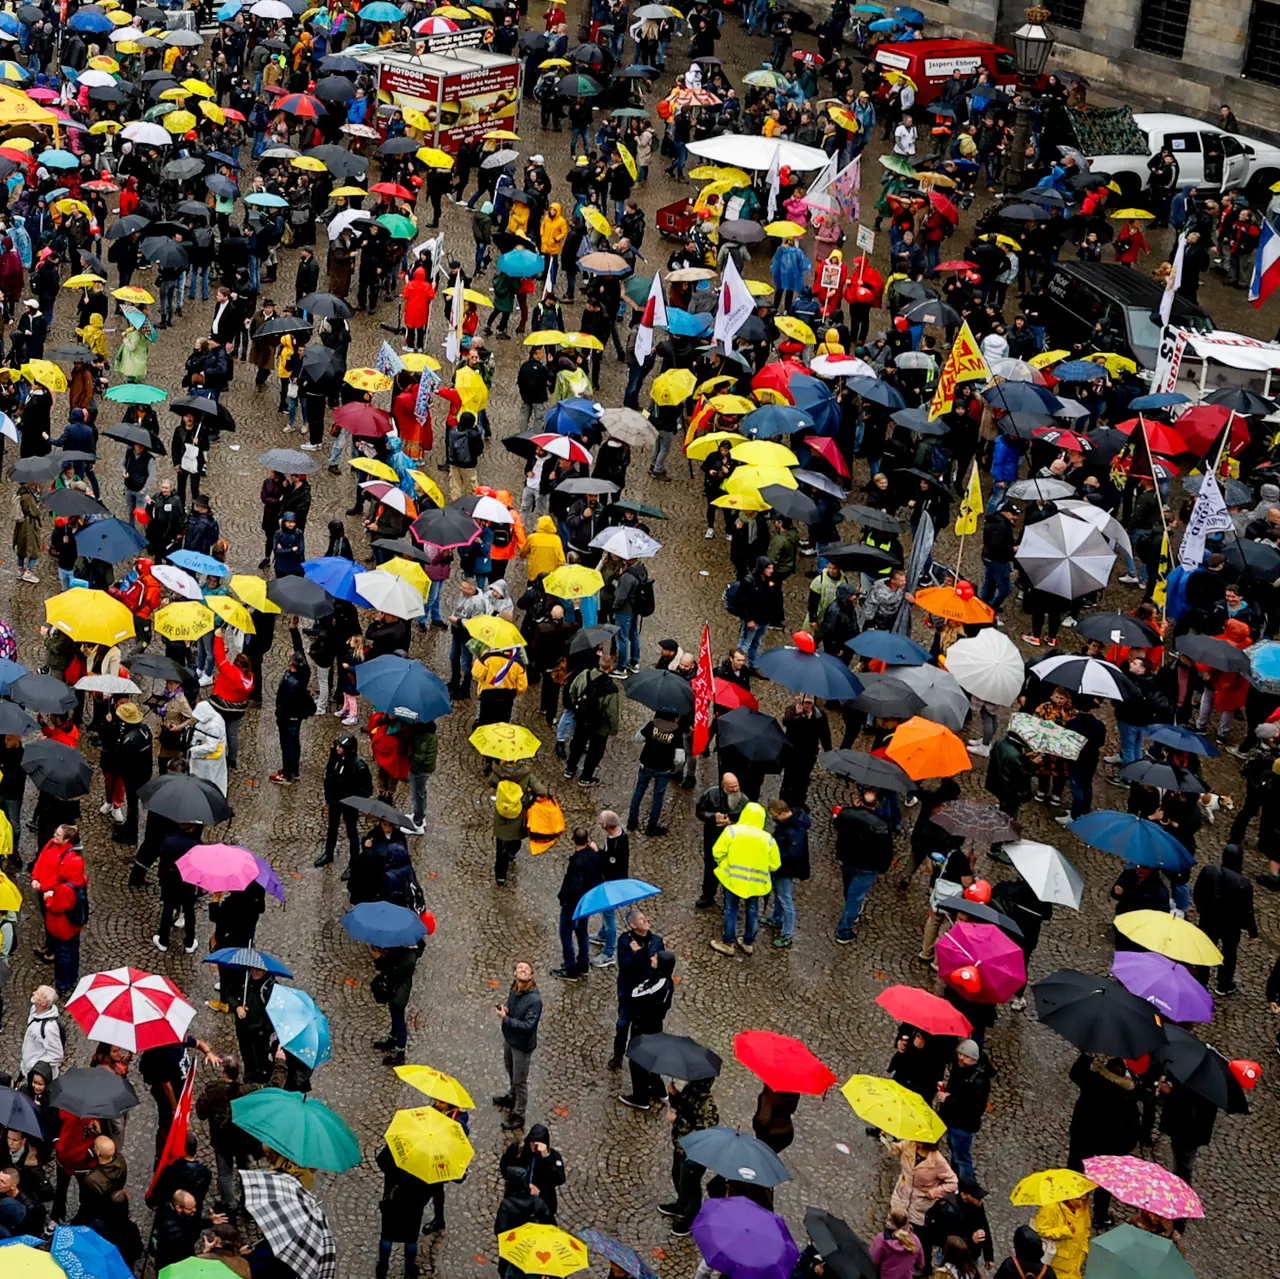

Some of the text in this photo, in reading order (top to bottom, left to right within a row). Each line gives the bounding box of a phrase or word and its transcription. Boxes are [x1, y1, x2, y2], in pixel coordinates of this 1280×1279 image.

[928, 59, 978, 69] Jaspers Ebbers
[390, 66, 424, 80] HOTDOGS
[461, 69, 490, 81] HOTDOGS
[508, 1238, 538, 1263] DANS
